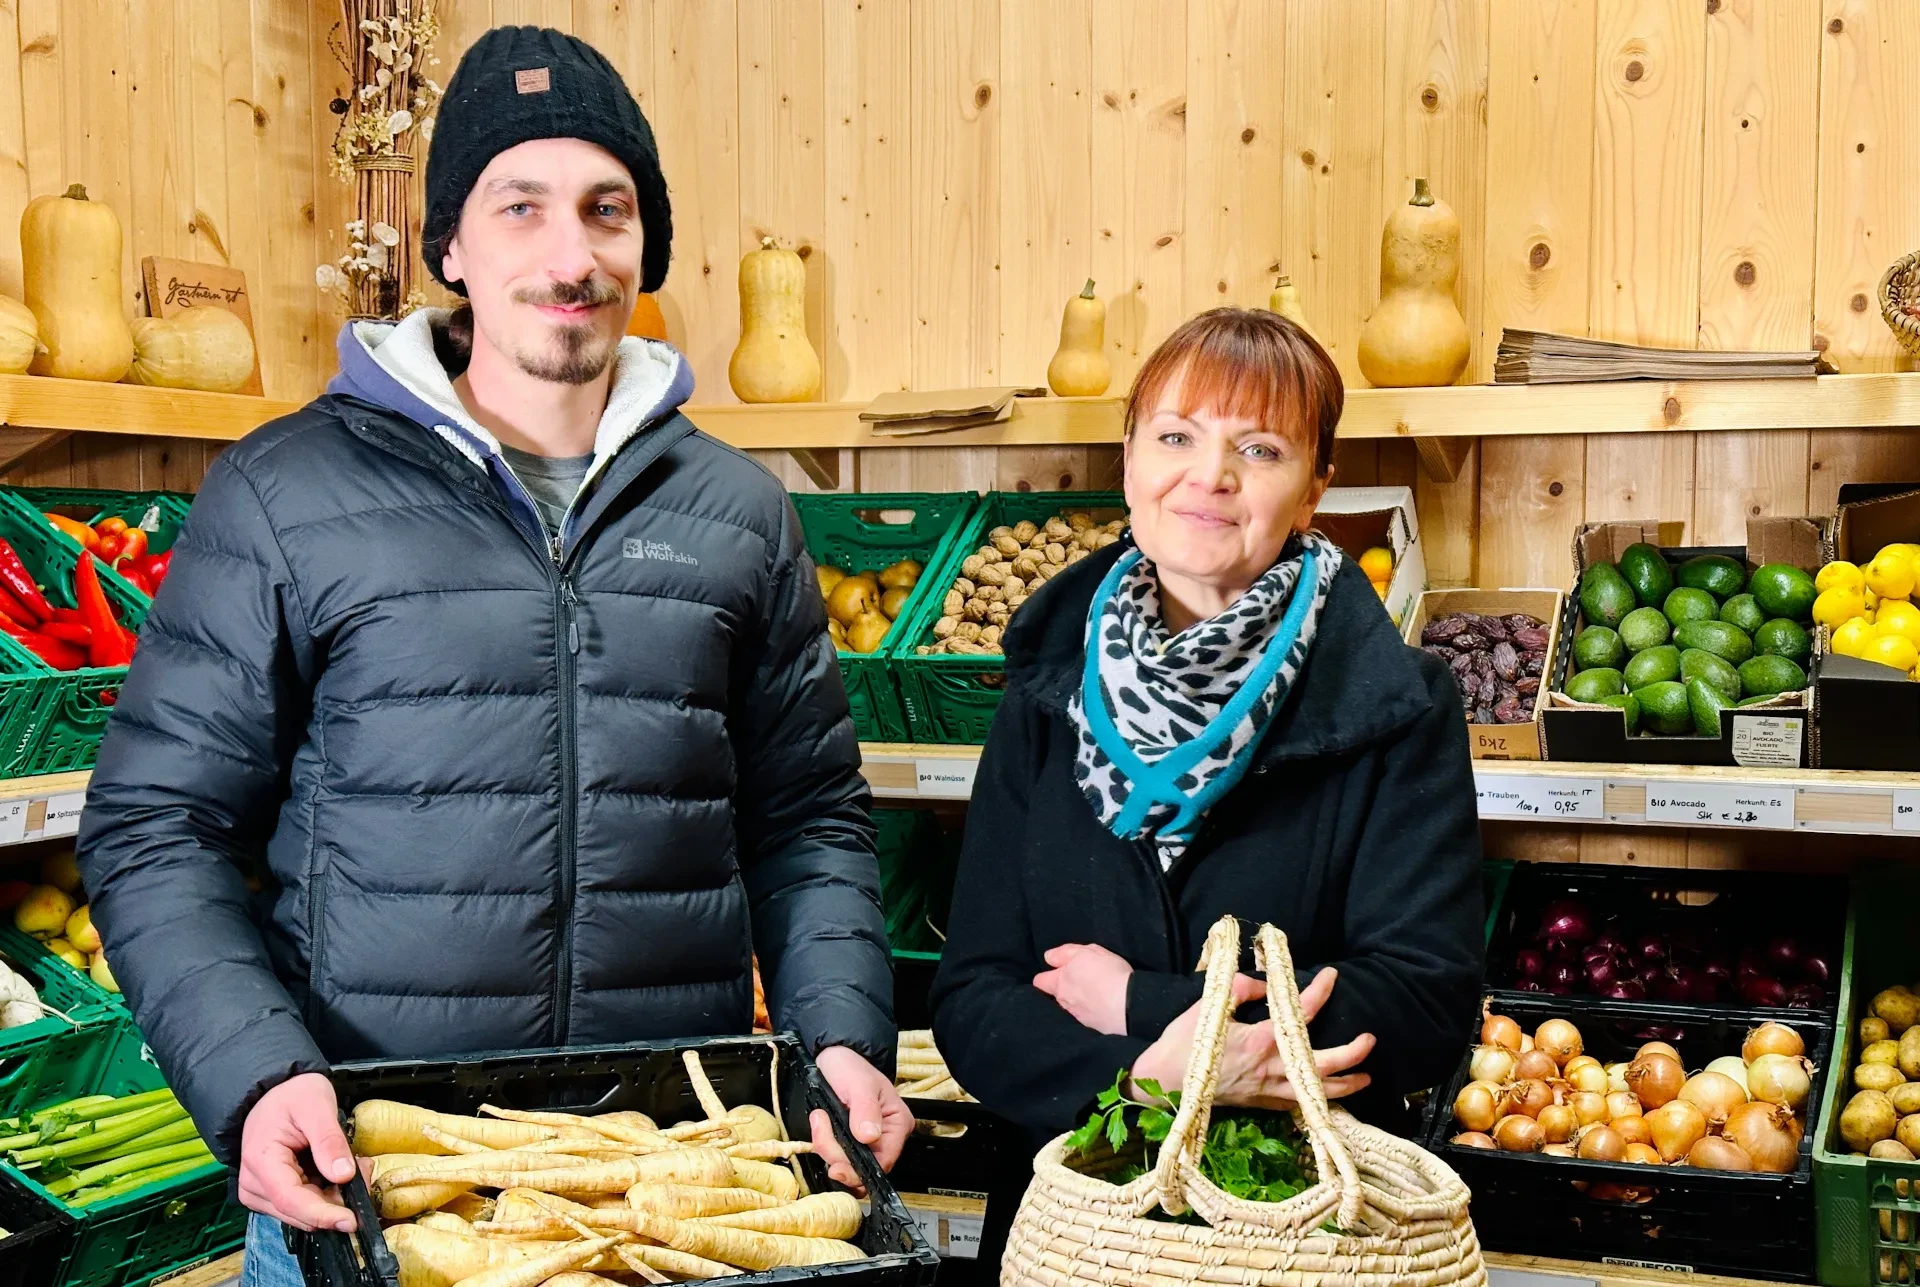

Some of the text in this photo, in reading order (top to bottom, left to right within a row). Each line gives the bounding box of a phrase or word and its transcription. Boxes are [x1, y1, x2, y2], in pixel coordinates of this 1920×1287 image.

[644, 540, 672, 551] Jack
[645, 550, 698, 566] Wolfskin
[1479, 734, 1507, 750] 2kg
[934, 774, 966, 782] Walnüsse
[1488, 791, 1520, 799] Trauben
[1554, 801, 1580, 814] 0,95
[1651, 799, 1706, 808] BIO Avocado
[1897, 805, 1913, 814] BIO
